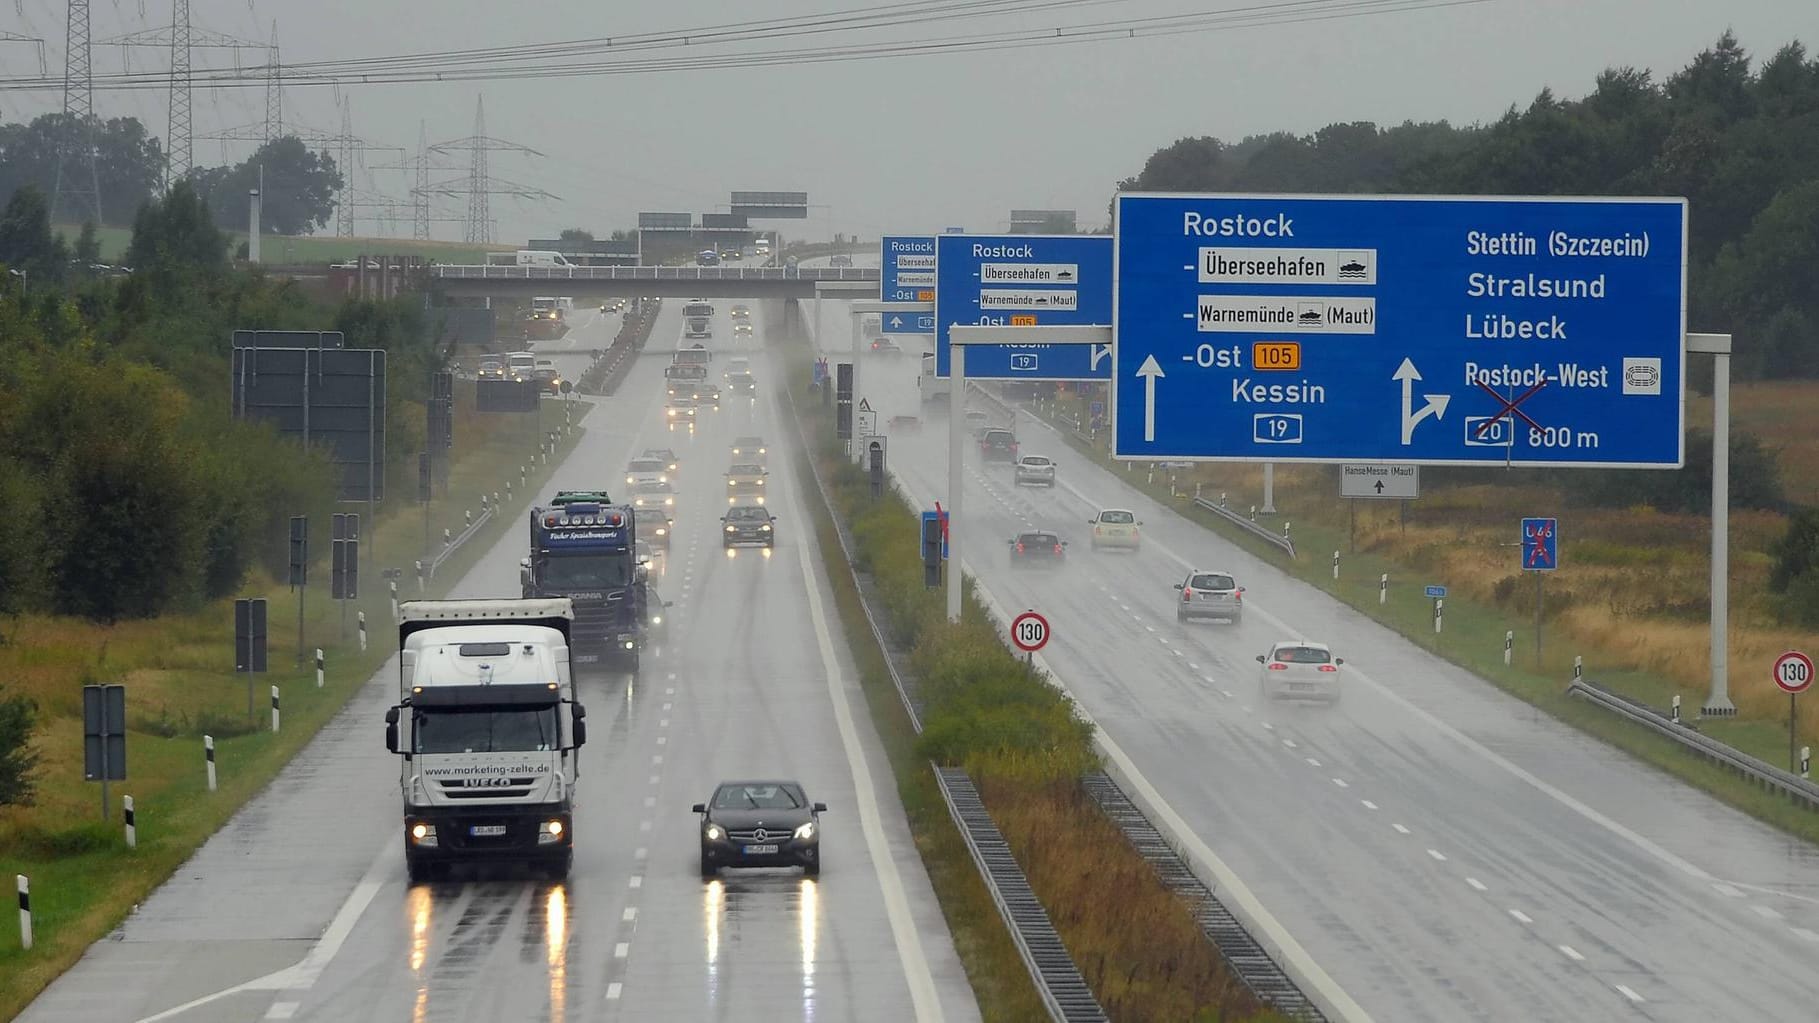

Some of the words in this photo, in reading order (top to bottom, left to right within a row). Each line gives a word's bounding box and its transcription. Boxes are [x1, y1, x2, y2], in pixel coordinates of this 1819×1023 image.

[1184, 212, 1294, 236] Rostock
[891, 242, 933, 252] Rostock
[973, 244, 1033, 258] Rostock
[1467, 231, 1536, 256] Stettin
[1548, 230, 1650, 257] (Szczecin)
[985, 265, 1050, 280] Überseehafen
[1206, 251, 1325, 277] Überseehafen
[1467, 273, 1605, 298] Stralsund
[982, 295, 1033, 305] Warnemünde
[1050, 295, 1076, 305] (Maut)
[1200, 304, 1294, 323] Warnemünde
[1327, 306, 1375, 325] (Maut)
[1466, 314, 1567, 339] Lübeck
[1019, 357, 1030, 367] 19
[1262, 347, 1292, 364] 105
[1465, 362, 1608, 388] Rostock-West
[1232, 378, 1325, 404] Kessin
[1268, 420, 1288, 437] 19
[1477, 423, 1502, 440] 20
[1528, 426, 1571, 448] 800
[1577, 432, 1599, 448] m
[1391, 466, 1413, 476] (Maut)
[1019, 623, 1042, 641] 130
[1782, 663, 1806, 681] 130
[425, 763, 550, 776] www.marketing-zelte.de
[463, 777, 511, 788] IVECO
